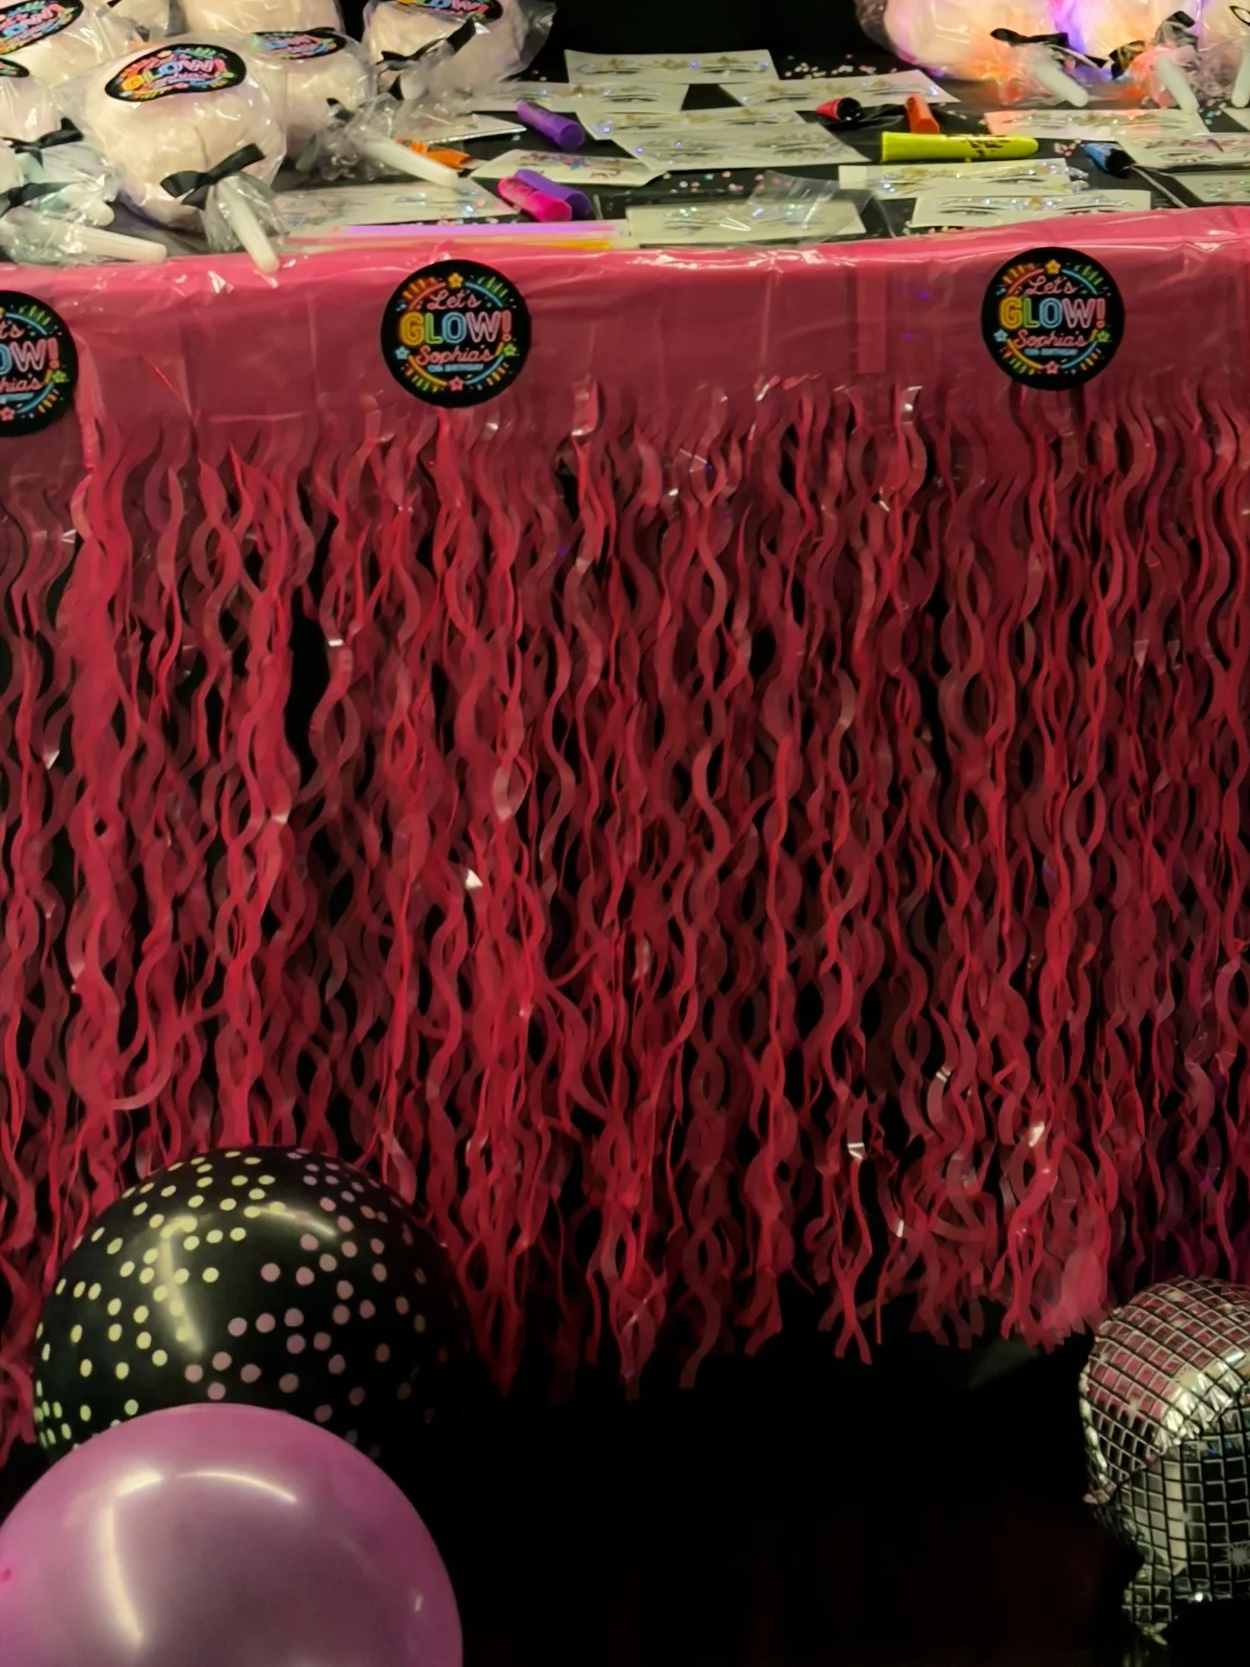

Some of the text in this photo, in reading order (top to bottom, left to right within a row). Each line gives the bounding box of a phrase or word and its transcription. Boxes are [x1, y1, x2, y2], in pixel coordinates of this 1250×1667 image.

[1025, 275, 1078, 295] Let's
[427, 289, 482, 310] Let's
[1000, 296, 1106, 329] GLOW!
[400, 310, 512, 345] GLOW!
[1015, 329, 1088, 348] Sophia's
[416, 345, 494, 366] Sophia's
